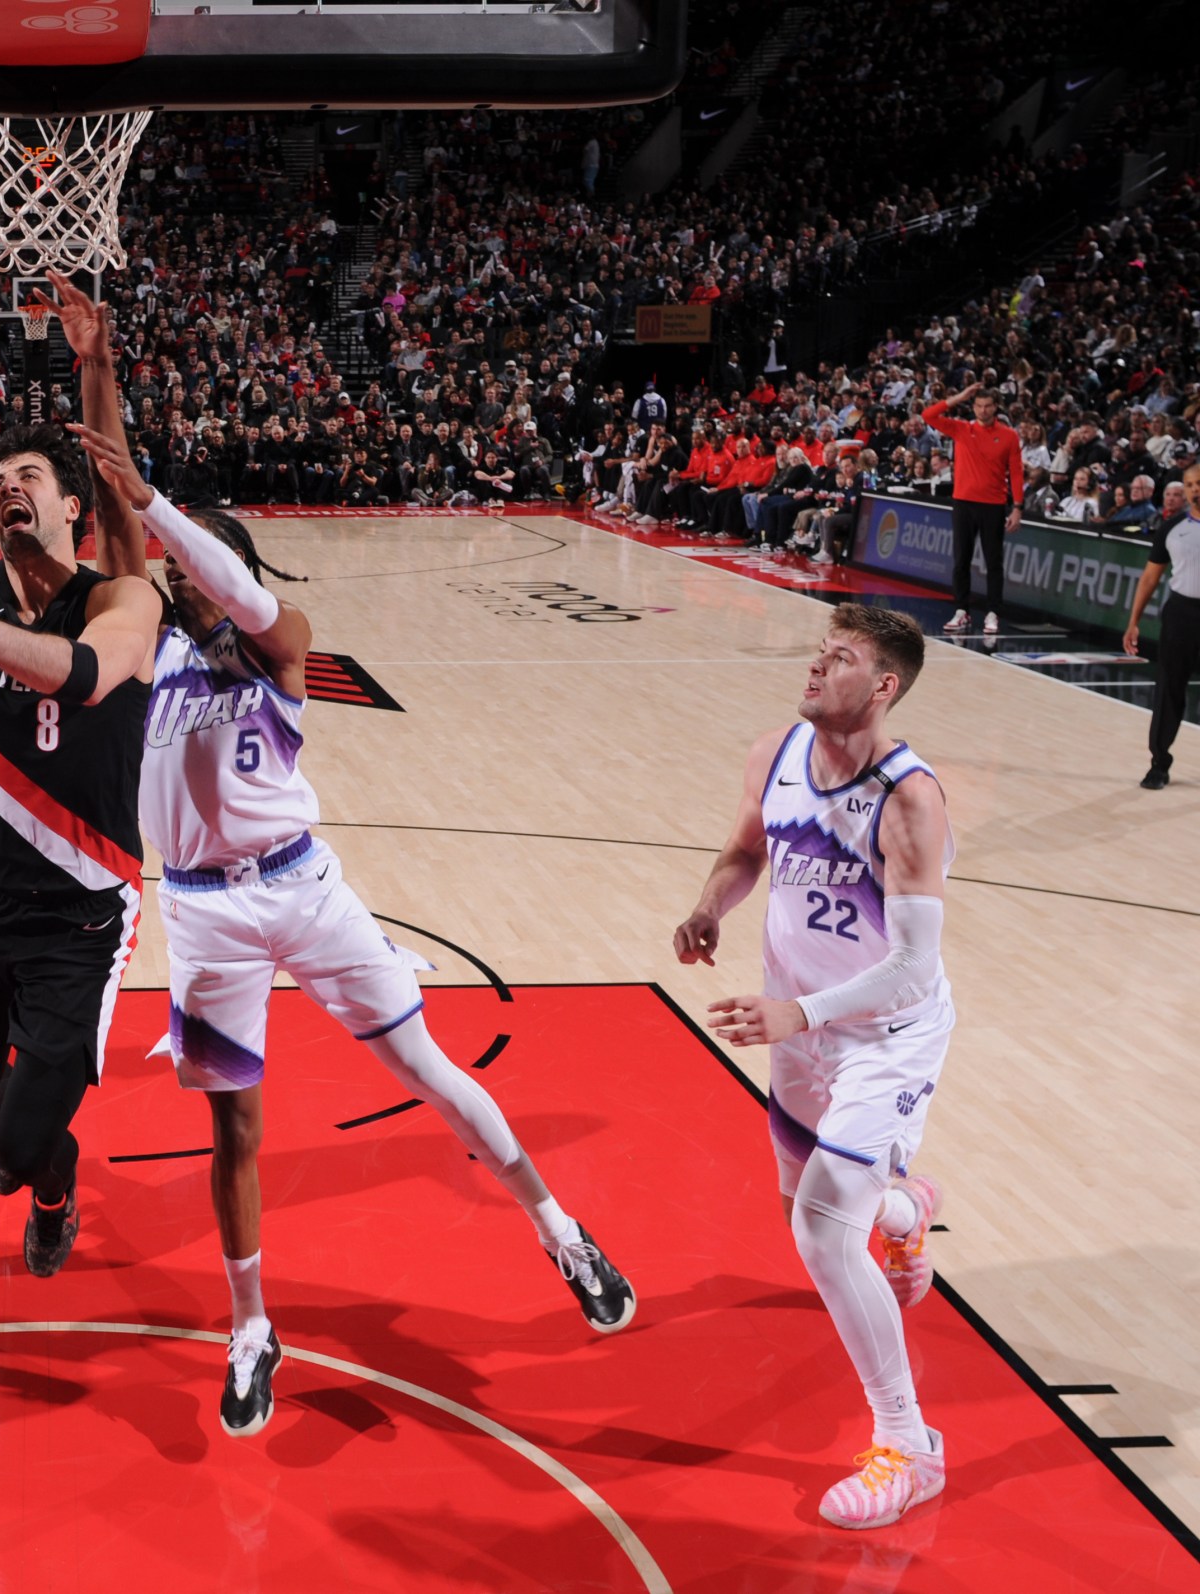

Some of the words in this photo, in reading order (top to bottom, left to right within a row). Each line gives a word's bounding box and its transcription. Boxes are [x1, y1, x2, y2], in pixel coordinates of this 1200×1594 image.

[27, 379, 46, 425] xfinit
[900, 514, 953, 556] axiom
[445, 582, 553, 623] center
[500, 581, 647, 623] moda
[36, 697, 60, 752] 8
[146, 685, 264, 749] UTAH
[235, 728, 261, 773] 5
[846, 797, 874, 817] LVT
[806, 890, 860, 943] 22
